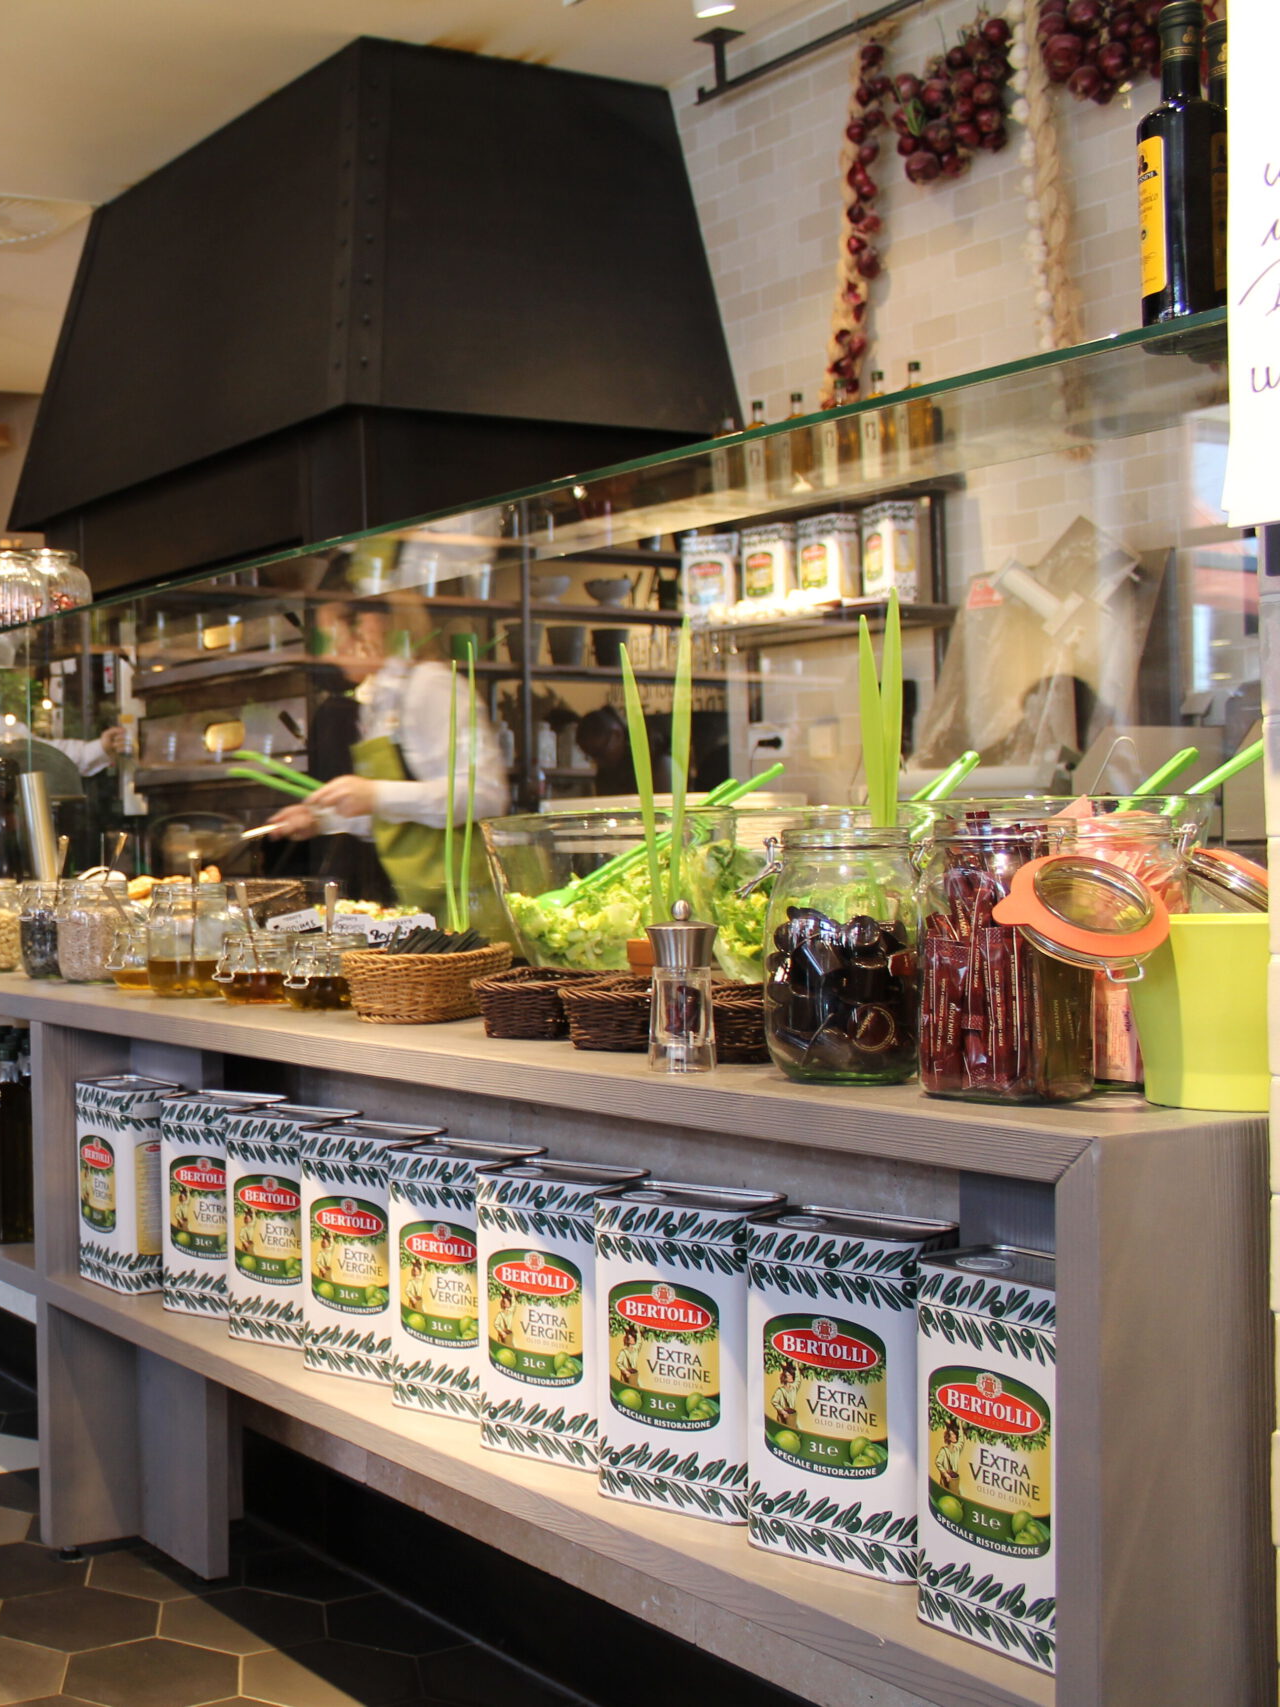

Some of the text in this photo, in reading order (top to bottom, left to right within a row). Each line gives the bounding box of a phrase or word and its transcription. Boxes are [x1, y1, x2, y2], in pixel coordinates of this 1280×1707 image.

[180, 1170, 226, 1184] BERTOLL
[199, 1201, 227, 1214] EXTRA
[244, 1189, 296, 1207] BERTOLLI
[193, 1210, 227, 1224] VERGIN
[322, 1212, 377, 1231] BERTOLLI
[259, 1232, 301, 1250] VERGINE
[265, 1223, 296, 1238] EXTRA
[344, 1248, 377, 1264] EXTRA
[412, 1237, 472, 1258] BERTOLLI
[337, 1258, 383, 1277] VERGINE
[501, 1266, 568, 1290] BERTOLLI
[436, 1276, 472, 1294] EXTRA
[429, 1287, 478, 1308] VERGINE
[528, 1309, 568, 1329] EXTRA
[624, 1300, 704, 1326] BERTOLLI
[406, 1326, 434, 1344] SPECIALE
[520, 1321, 575, 1344] VERGINE
[656, 1346, 703, 1367] EXTRA
[782, 1334, 869, 1365] BERTOLLI
[495, 1362, 575, 1386] SPECIALE RISTORAZIONE
[646, 1359, 711, 1384] VERGINE
[817, 1384, 868, 1410] EXTRA
[617, 1404, 711, 1430] SPECIALE RISTORAZIONE
[806, 1398, 878, 1428] VERGINE
[946, 1388, 1033, 1429] BERTOLLI
[814, 1418, 870, 1434] OLIO DI OLIVA
[773, 1446, 877, 1477] SPECIALE RISTORAZIONE
[980, 1448, 1031, 1480] EXTRA
[968, 1462, 1040, 1501] VERGINE
[976, 1485, 1032, 1509] OLIO DI OLIVA
[936, 1512, 1040, 1556] SPECIALE RISTORAZIONE
